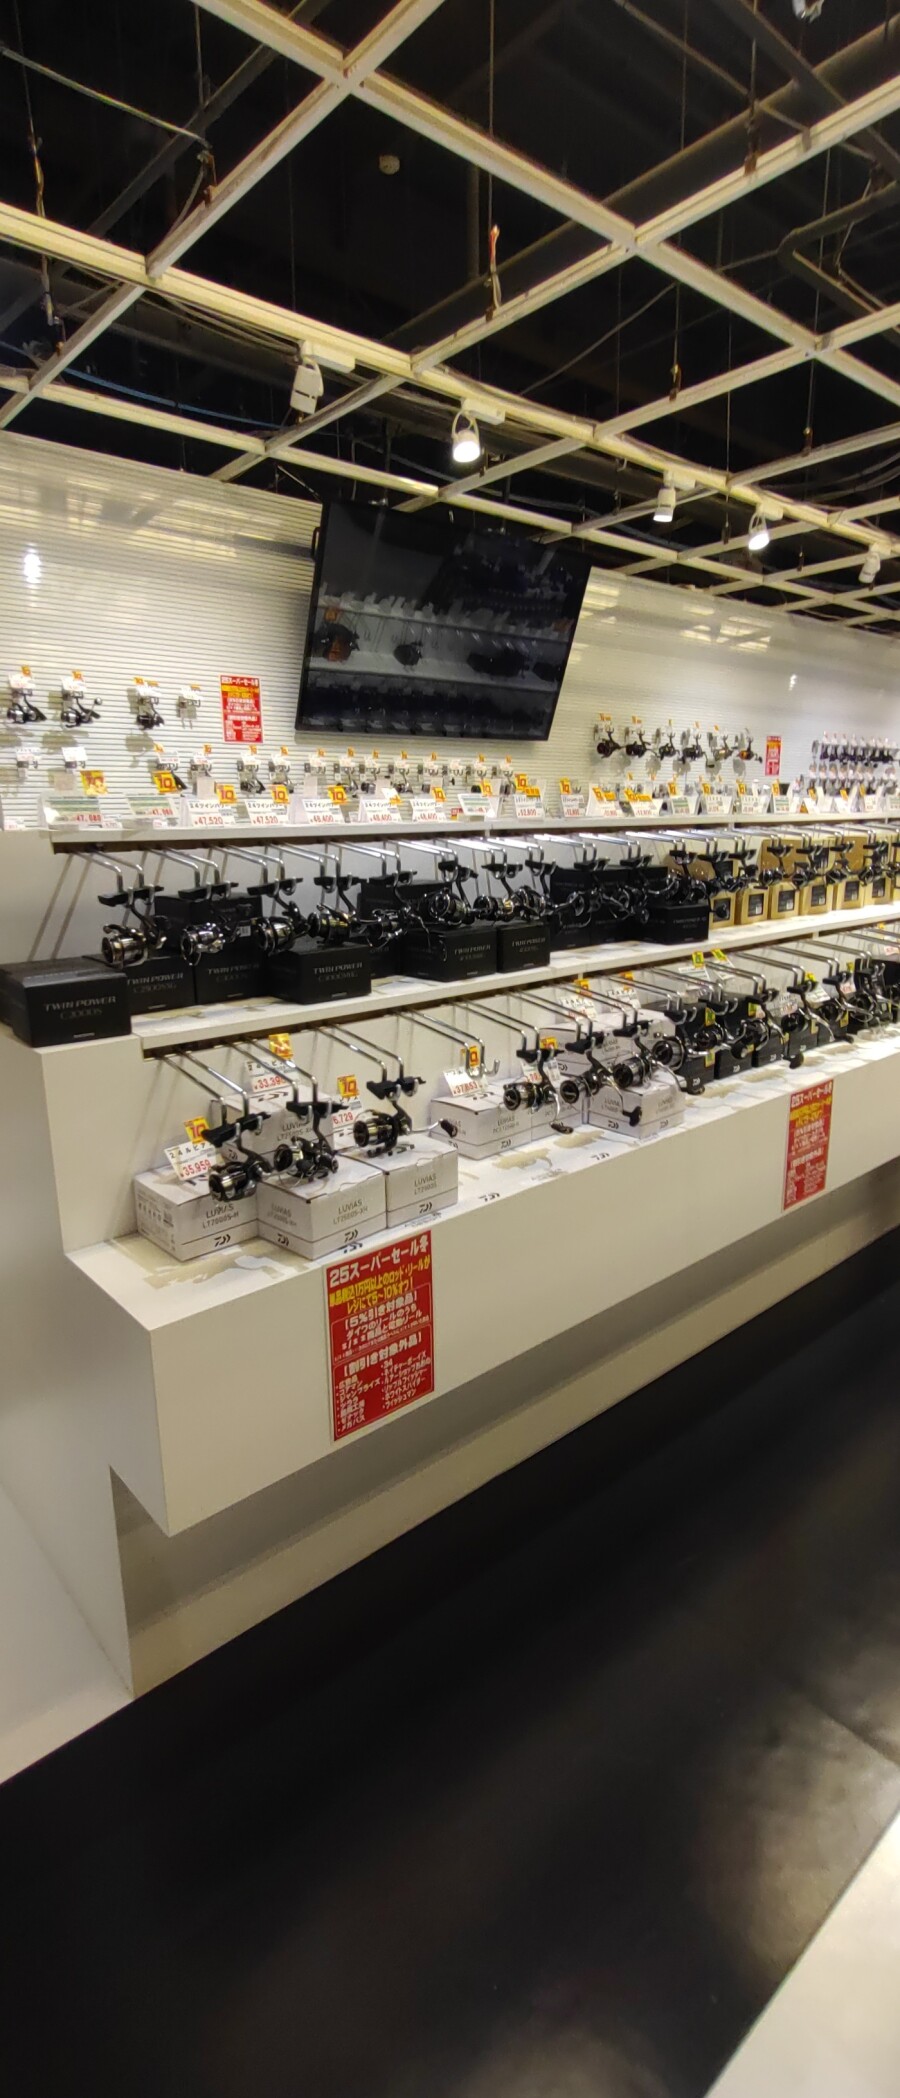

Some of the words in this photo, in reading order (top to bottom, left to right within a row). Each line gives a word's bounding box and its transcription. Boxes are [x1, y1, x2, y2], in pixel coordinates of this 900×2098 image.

[159, 777, 173, 789] 10
[221, 789, 234, 799] 10
[273, 790, 285, 800] 10
[45, 1000, 74, 1012] TWIN
[75, 995, 117, 1008] POWER
[180, 1159, 211, 1177] ¥35,959
[338, 1198, 363, 1215] LUVIAS
[329, 1234, 428, 1287] 25スーパーセール冬
